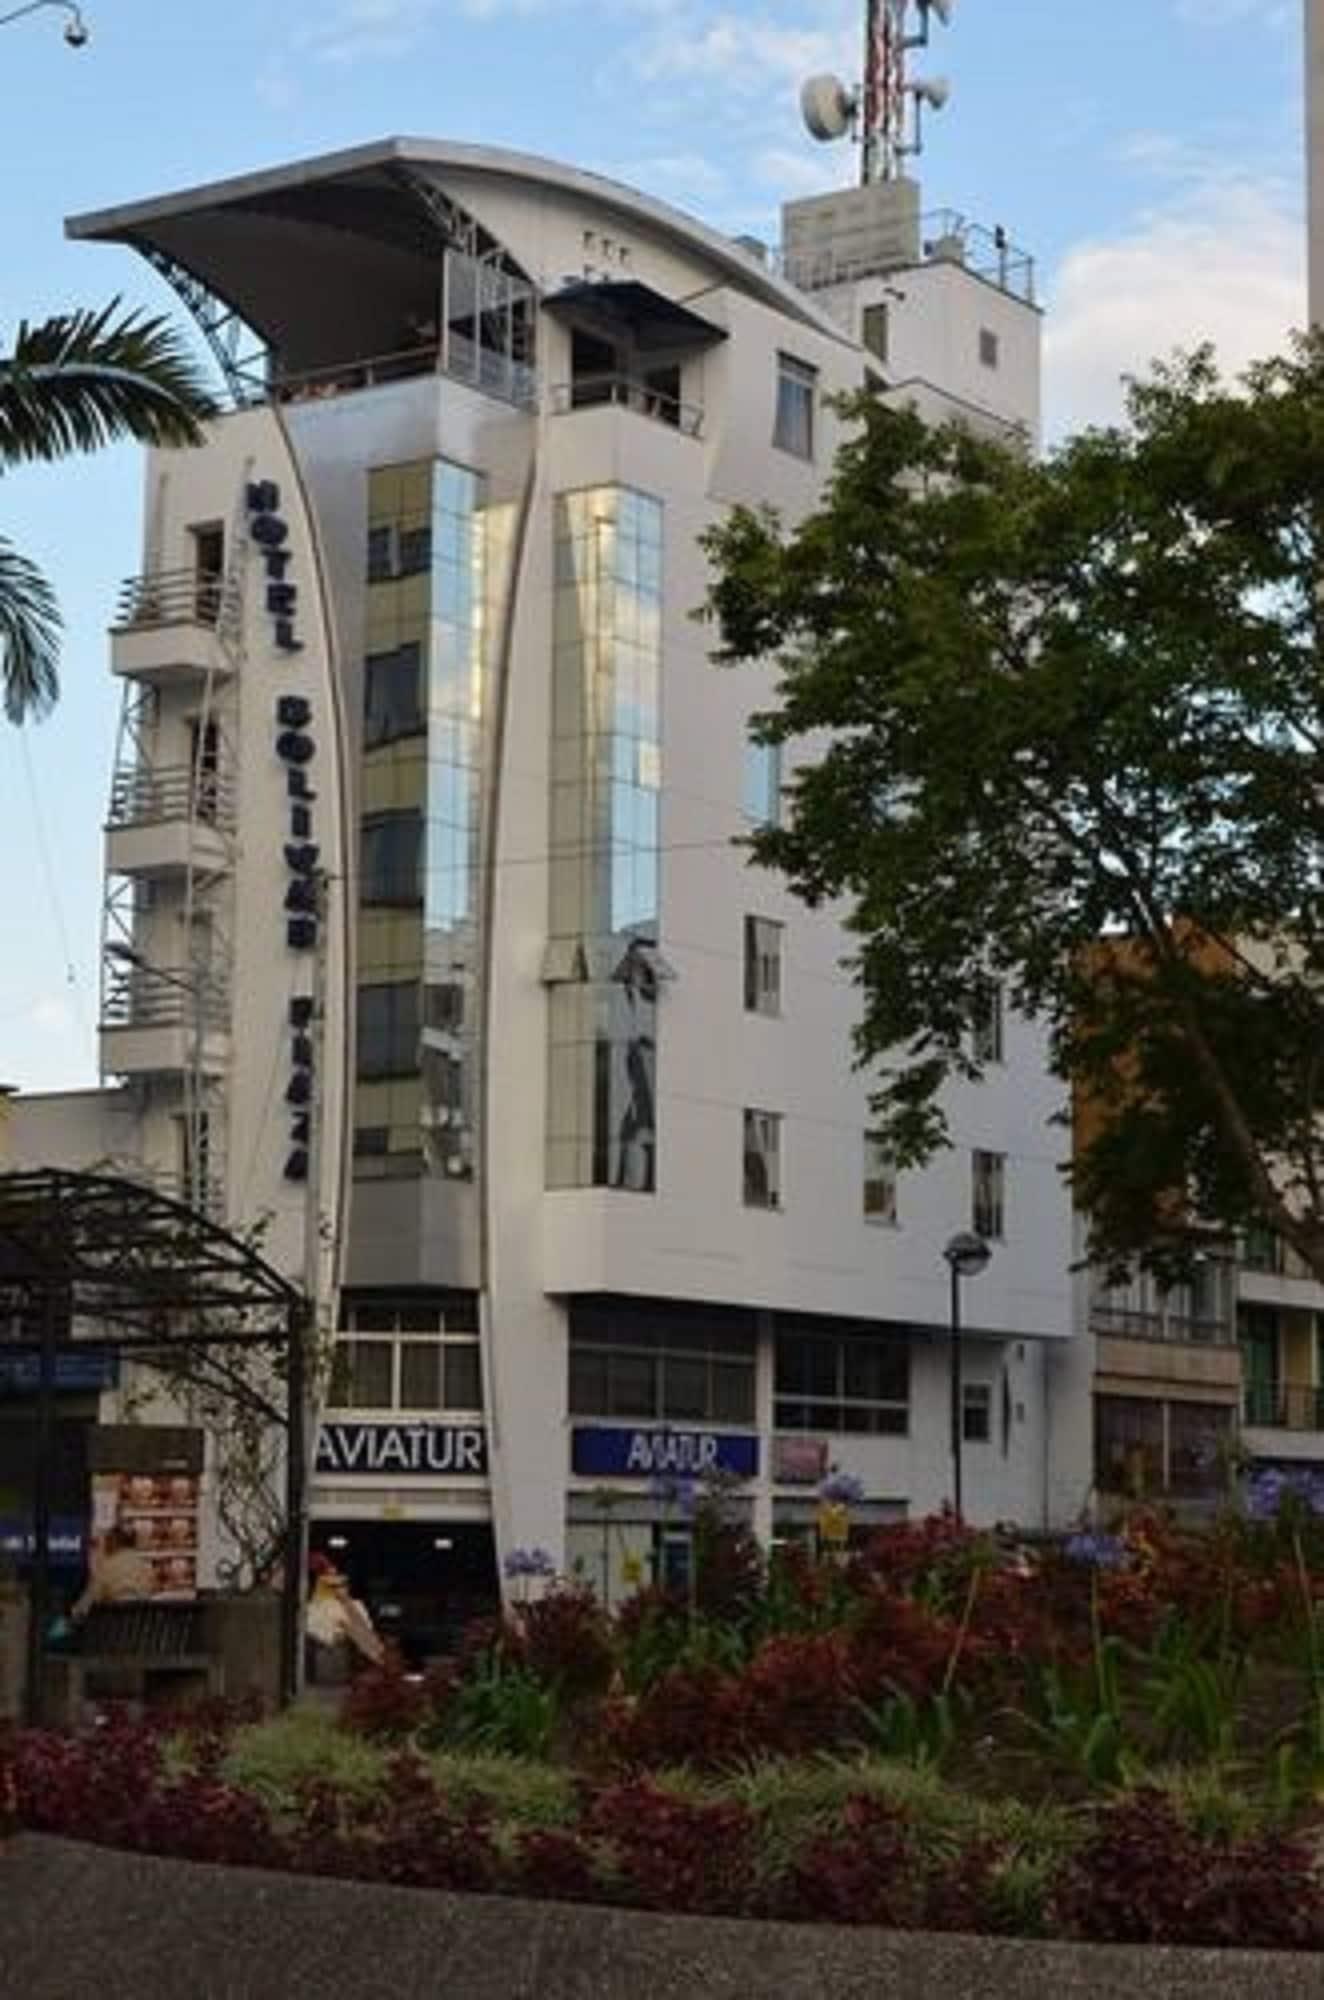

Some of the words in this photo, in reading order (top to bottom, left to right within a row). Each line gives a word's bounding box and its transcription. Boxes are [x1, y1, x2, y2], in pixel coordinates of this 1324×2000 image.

[245, 479, 305, 653] HOTEL
[317, 1426, 482, 1470] AVIATUR
[626, 1433, 719, 1472] AVIATUR
